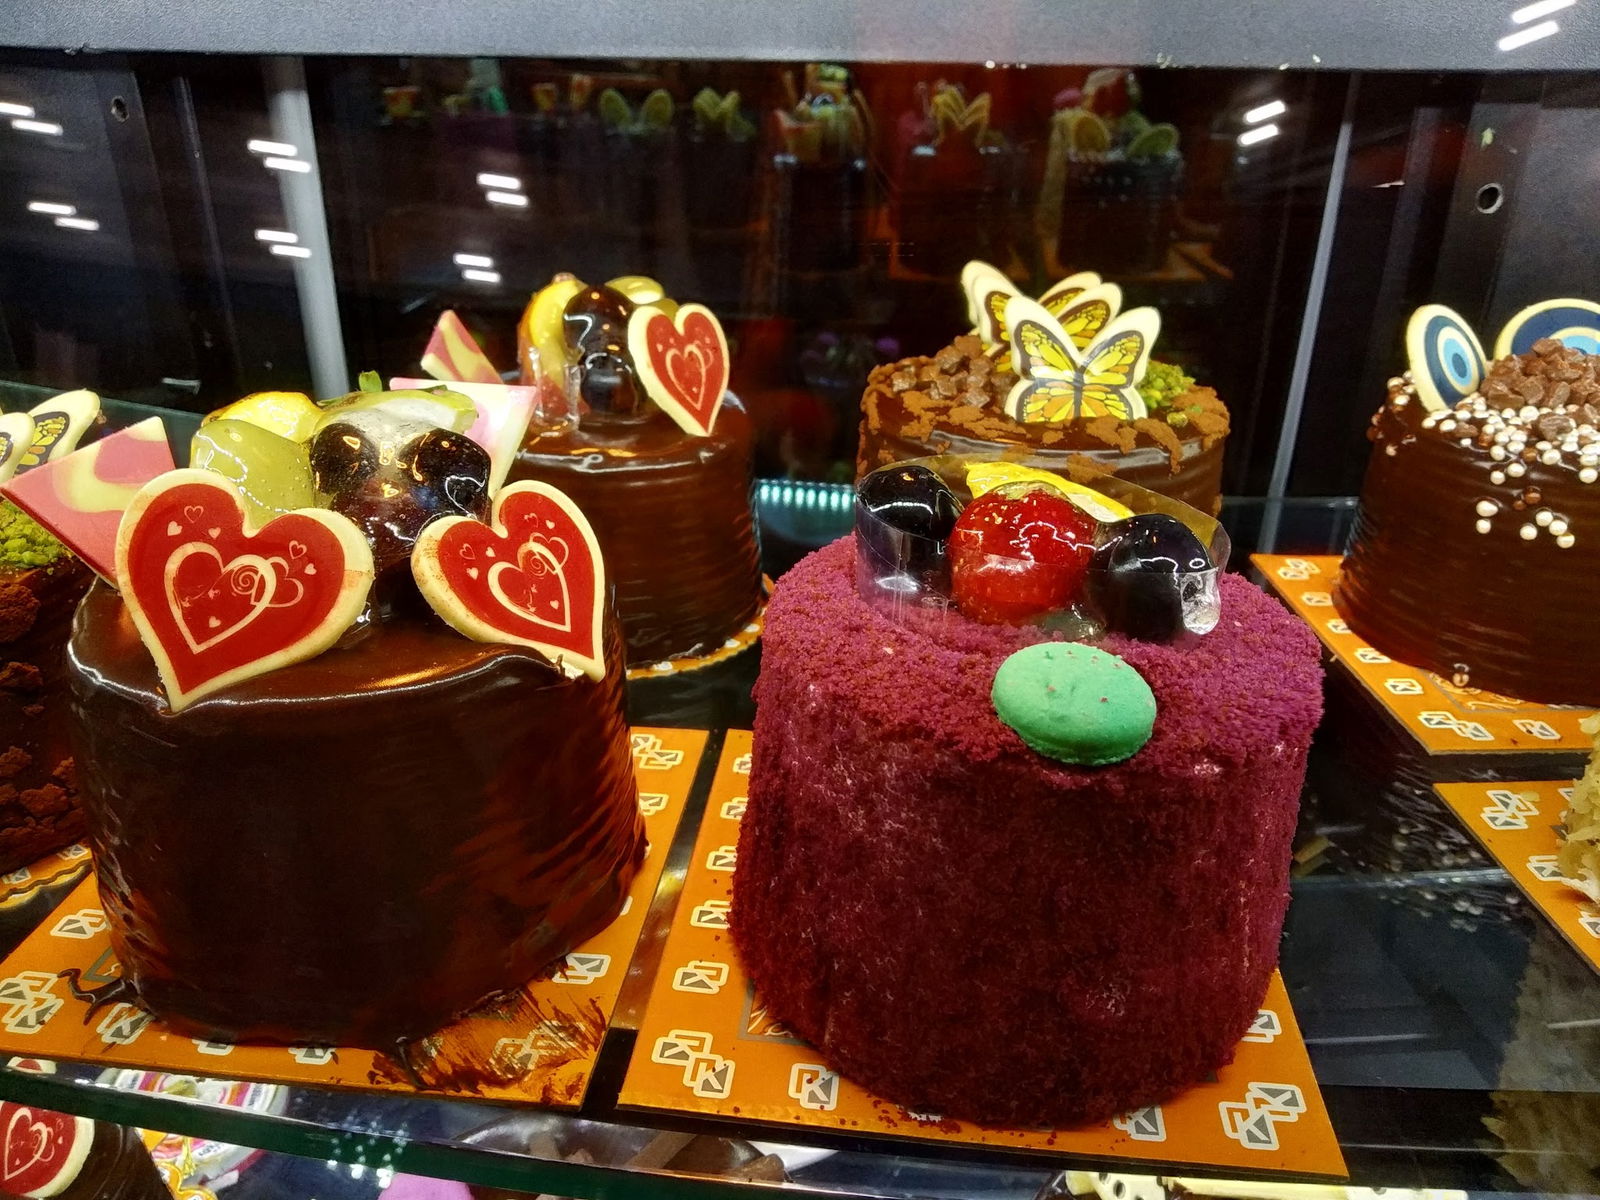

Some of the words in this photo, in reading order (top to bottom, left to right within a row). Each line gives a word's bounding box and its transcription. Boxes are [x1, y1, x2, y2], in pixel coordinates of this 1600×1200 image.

[678, 966, 721, 991] K
[696, 1060, 732, 1095] K
[800, 1070, 836, 1105] K
[1231, 1110, 1273, 1146] K
